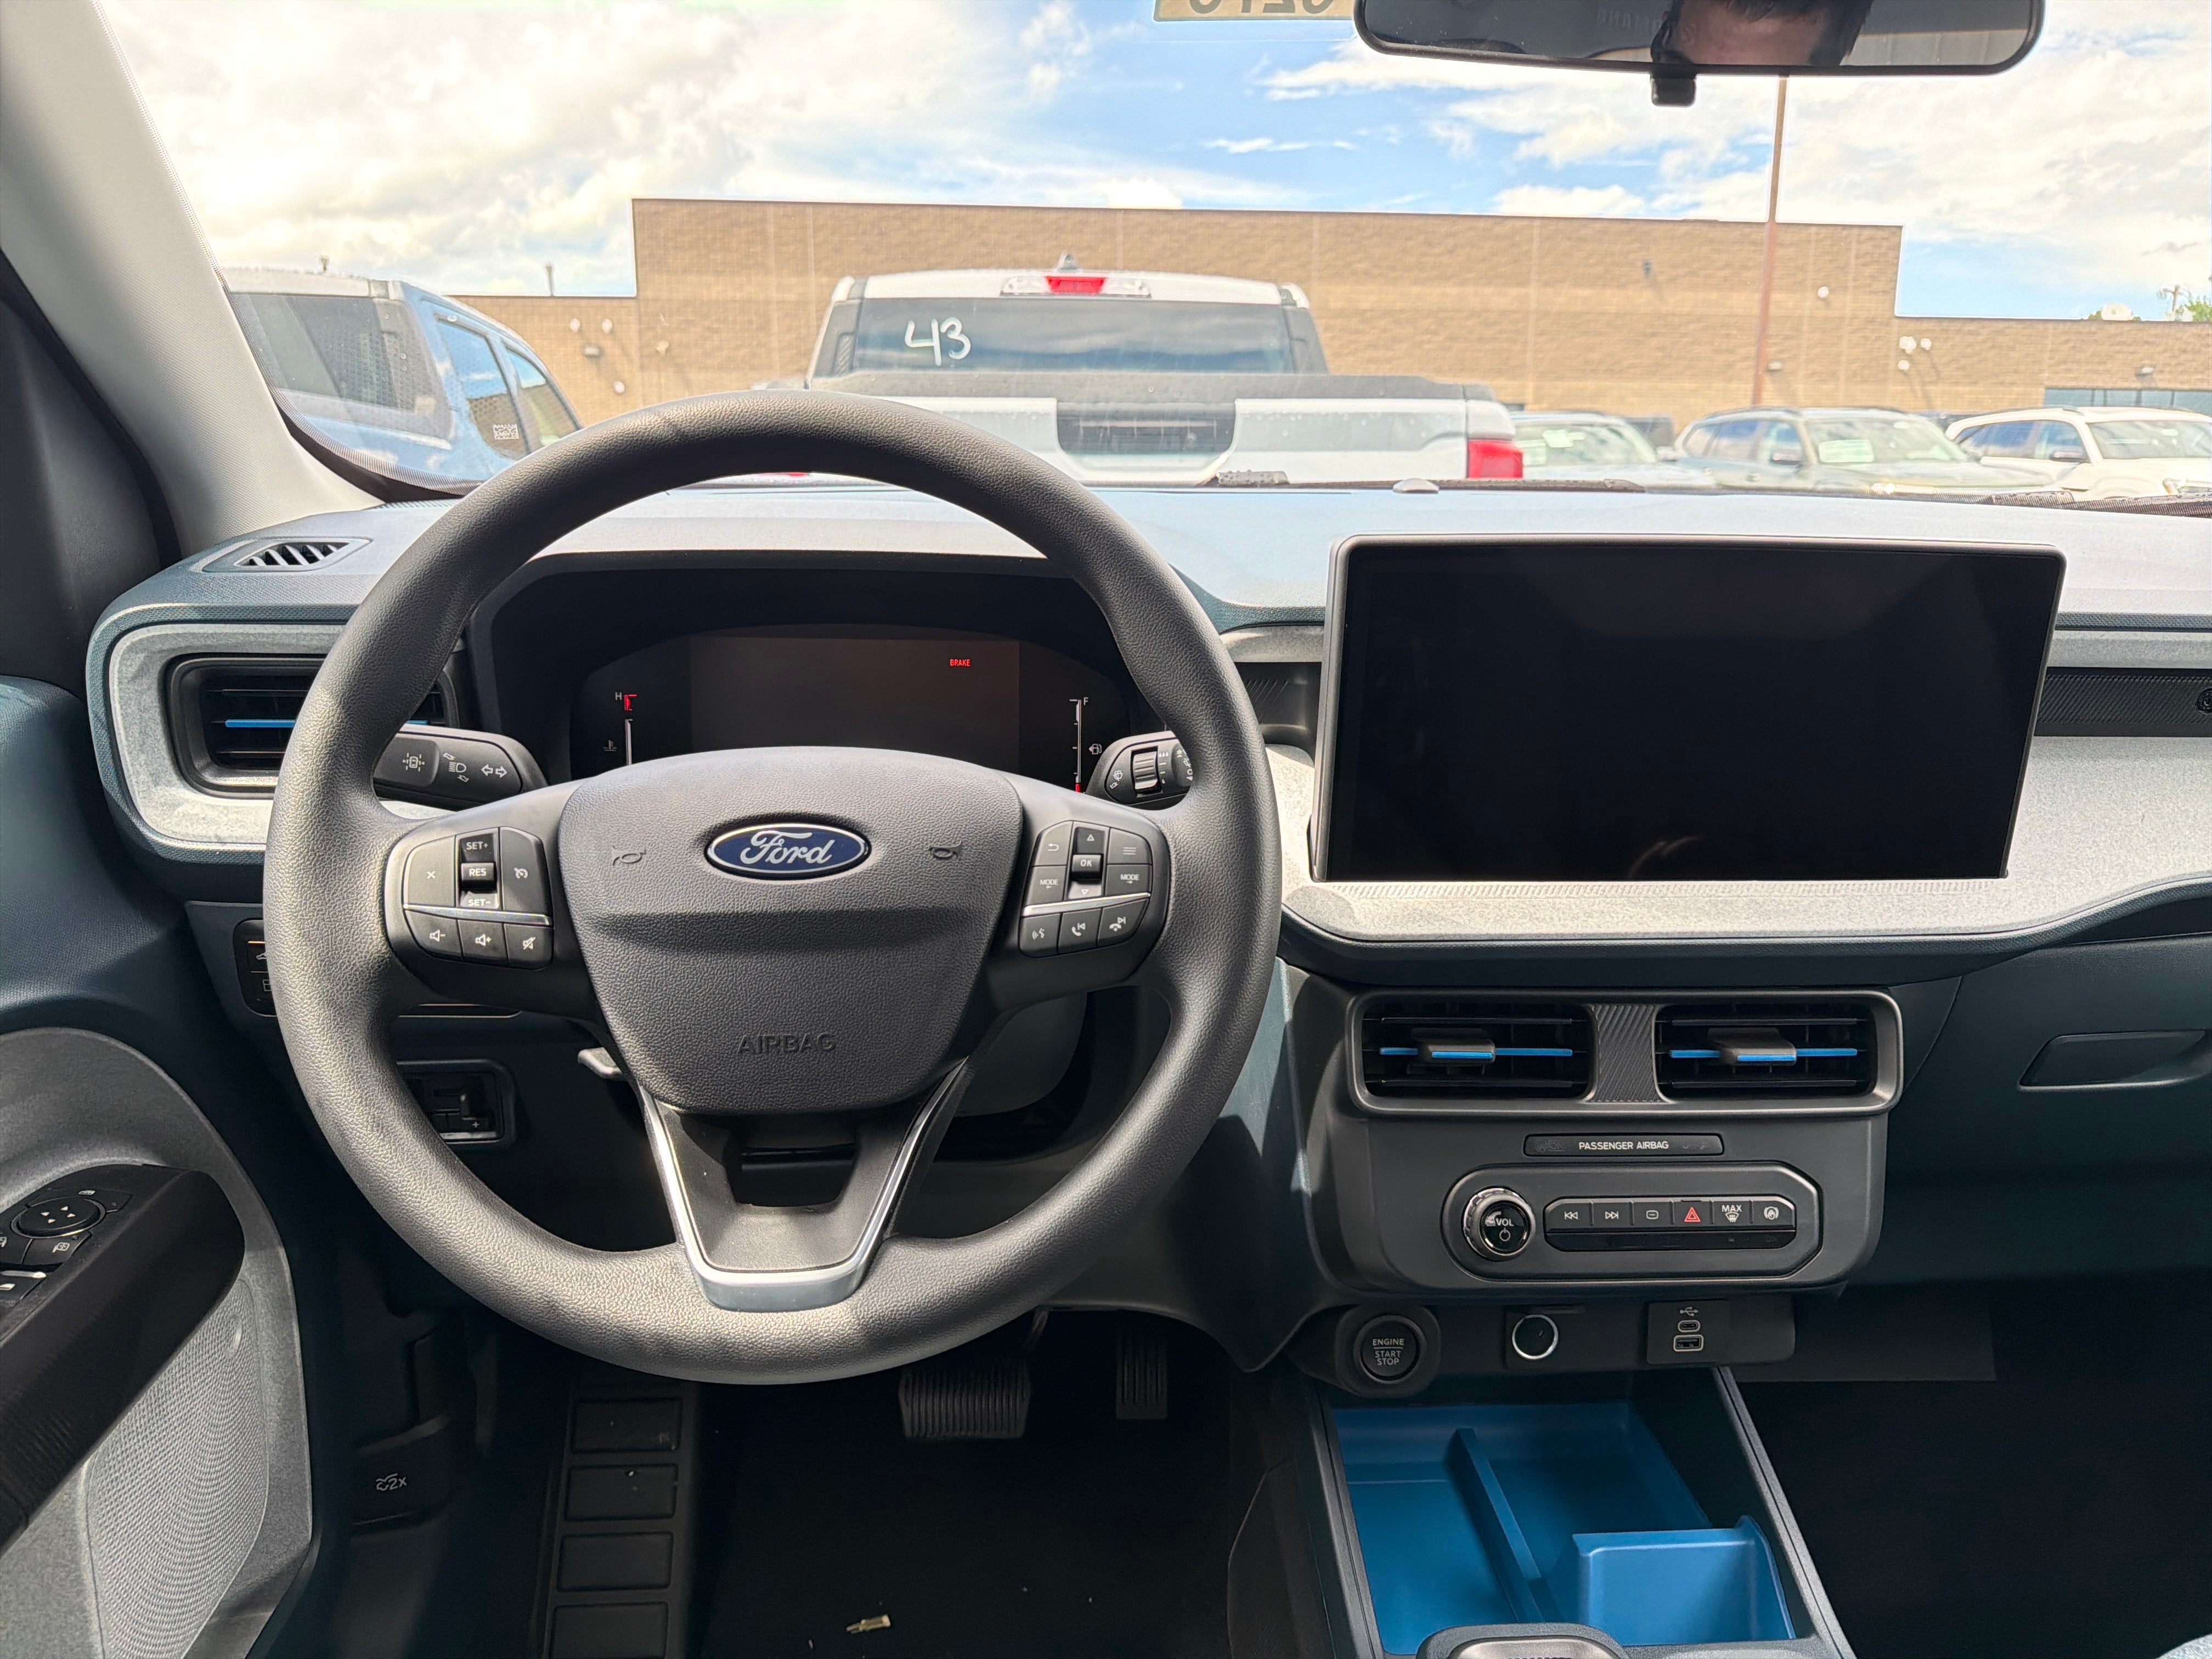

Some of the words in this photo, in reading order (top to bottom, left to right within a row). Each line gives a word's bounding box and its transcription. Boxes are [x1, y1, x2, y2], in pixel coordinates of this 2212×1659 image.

[904, 317, 971, 366] 43
[949, 658, 970, 667] BRAKE
[614, 691, 622, 701] H
[1084, 697, 1088, 706] F
[466, 841, 489, 850] SET+
[741, 831, 833, 865] Ford
[1080, 859, 1092, 867] OK
[469, 868, 487, 877] RES
[1120, 873, 1139, 882] MODE
[467, 899, 491, 907] SET-
[737, 1032, 836, 1055] AIRBAG
[1578, 1141, 1633, 1150] PASSENGER
[1636, 1140, 1669, 1149] AIRBAG
[1721, 1205, 1742, 1213] MAX
[1496, 1218, 1514, 1227] VOL
[1372, 1337, 1404, 1347] ENGINE
[1374, 1350, 1401, 1359] START
[1376, 1357, 1400, 1366] STOP
